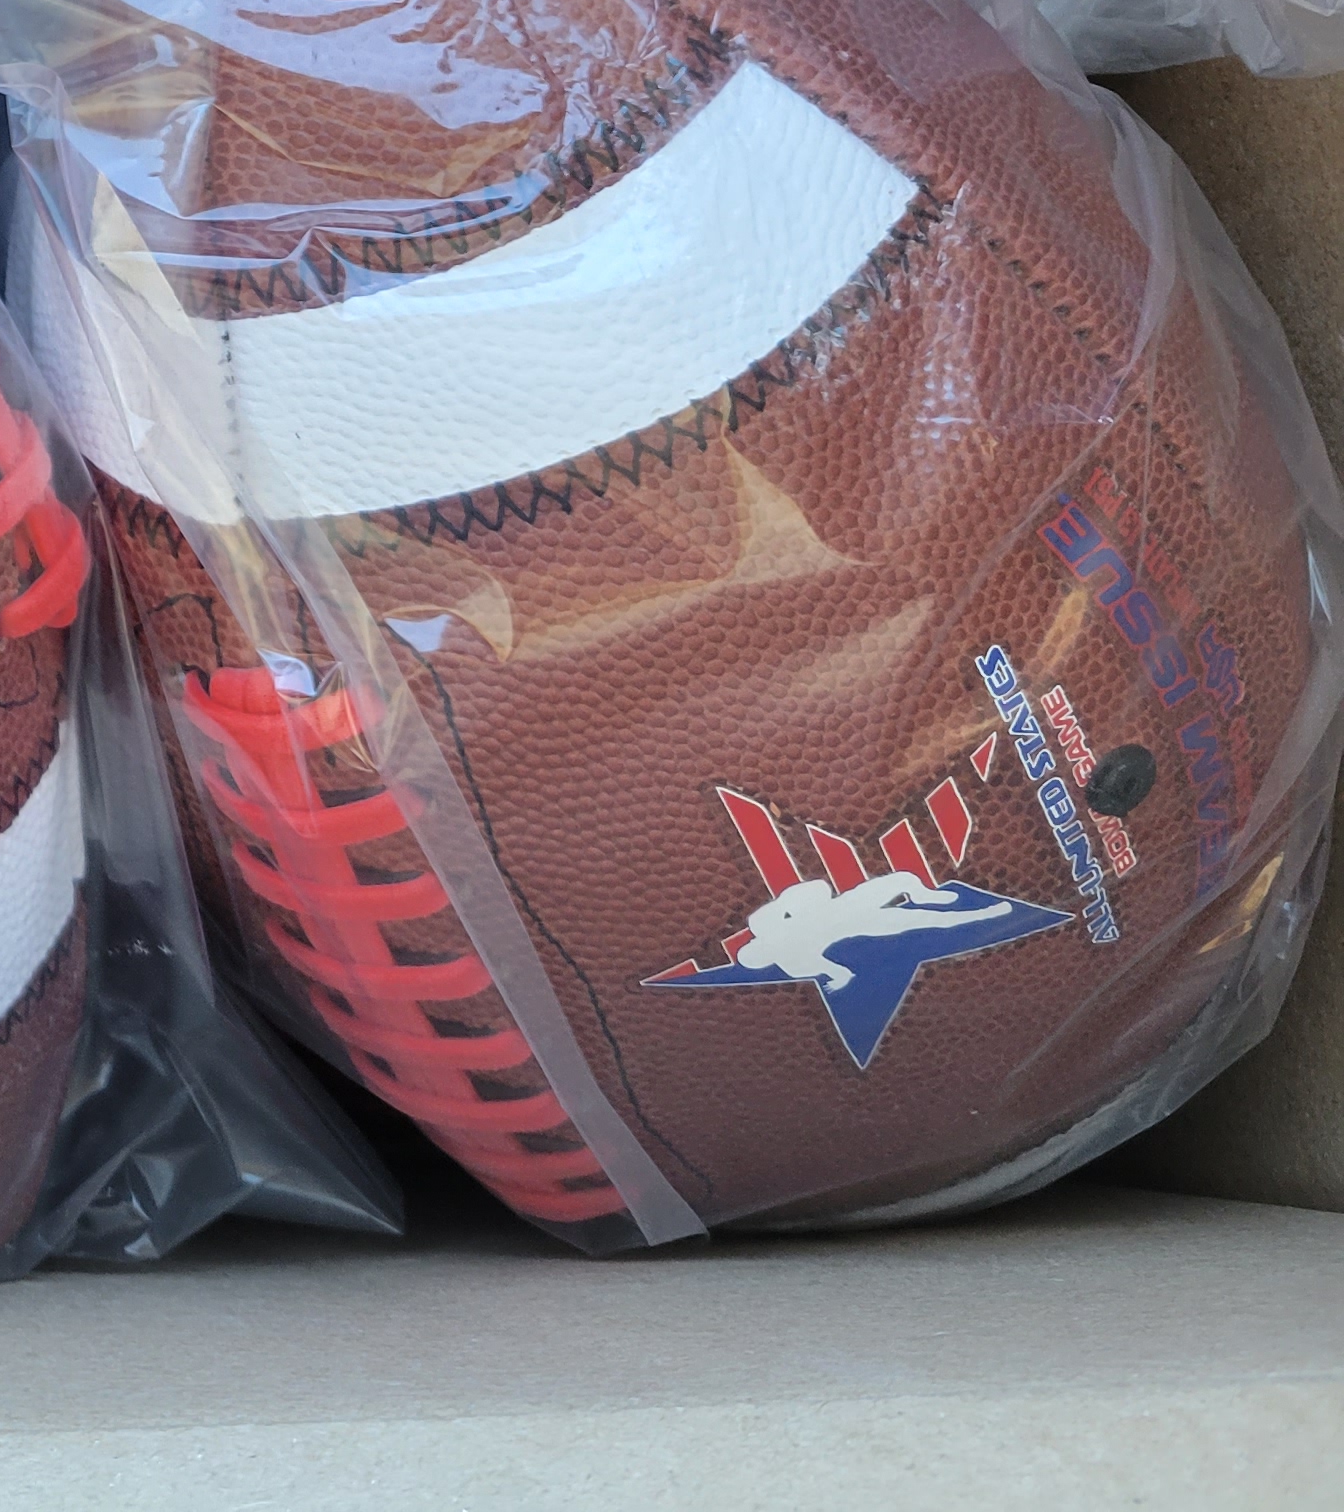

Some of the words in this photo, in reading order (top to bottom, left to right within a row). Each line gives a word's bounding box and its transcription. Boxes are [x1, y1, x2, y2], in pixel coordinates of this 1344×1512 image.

[975, 645, 1055, 781] STATES
[1196, 620, 1245, 719] USA
[1041, 685, 1097, 787] GAME
[1038, 776, 1119, 944] ALL-UNITED
[1088, 807, 1137, 878] BOW
